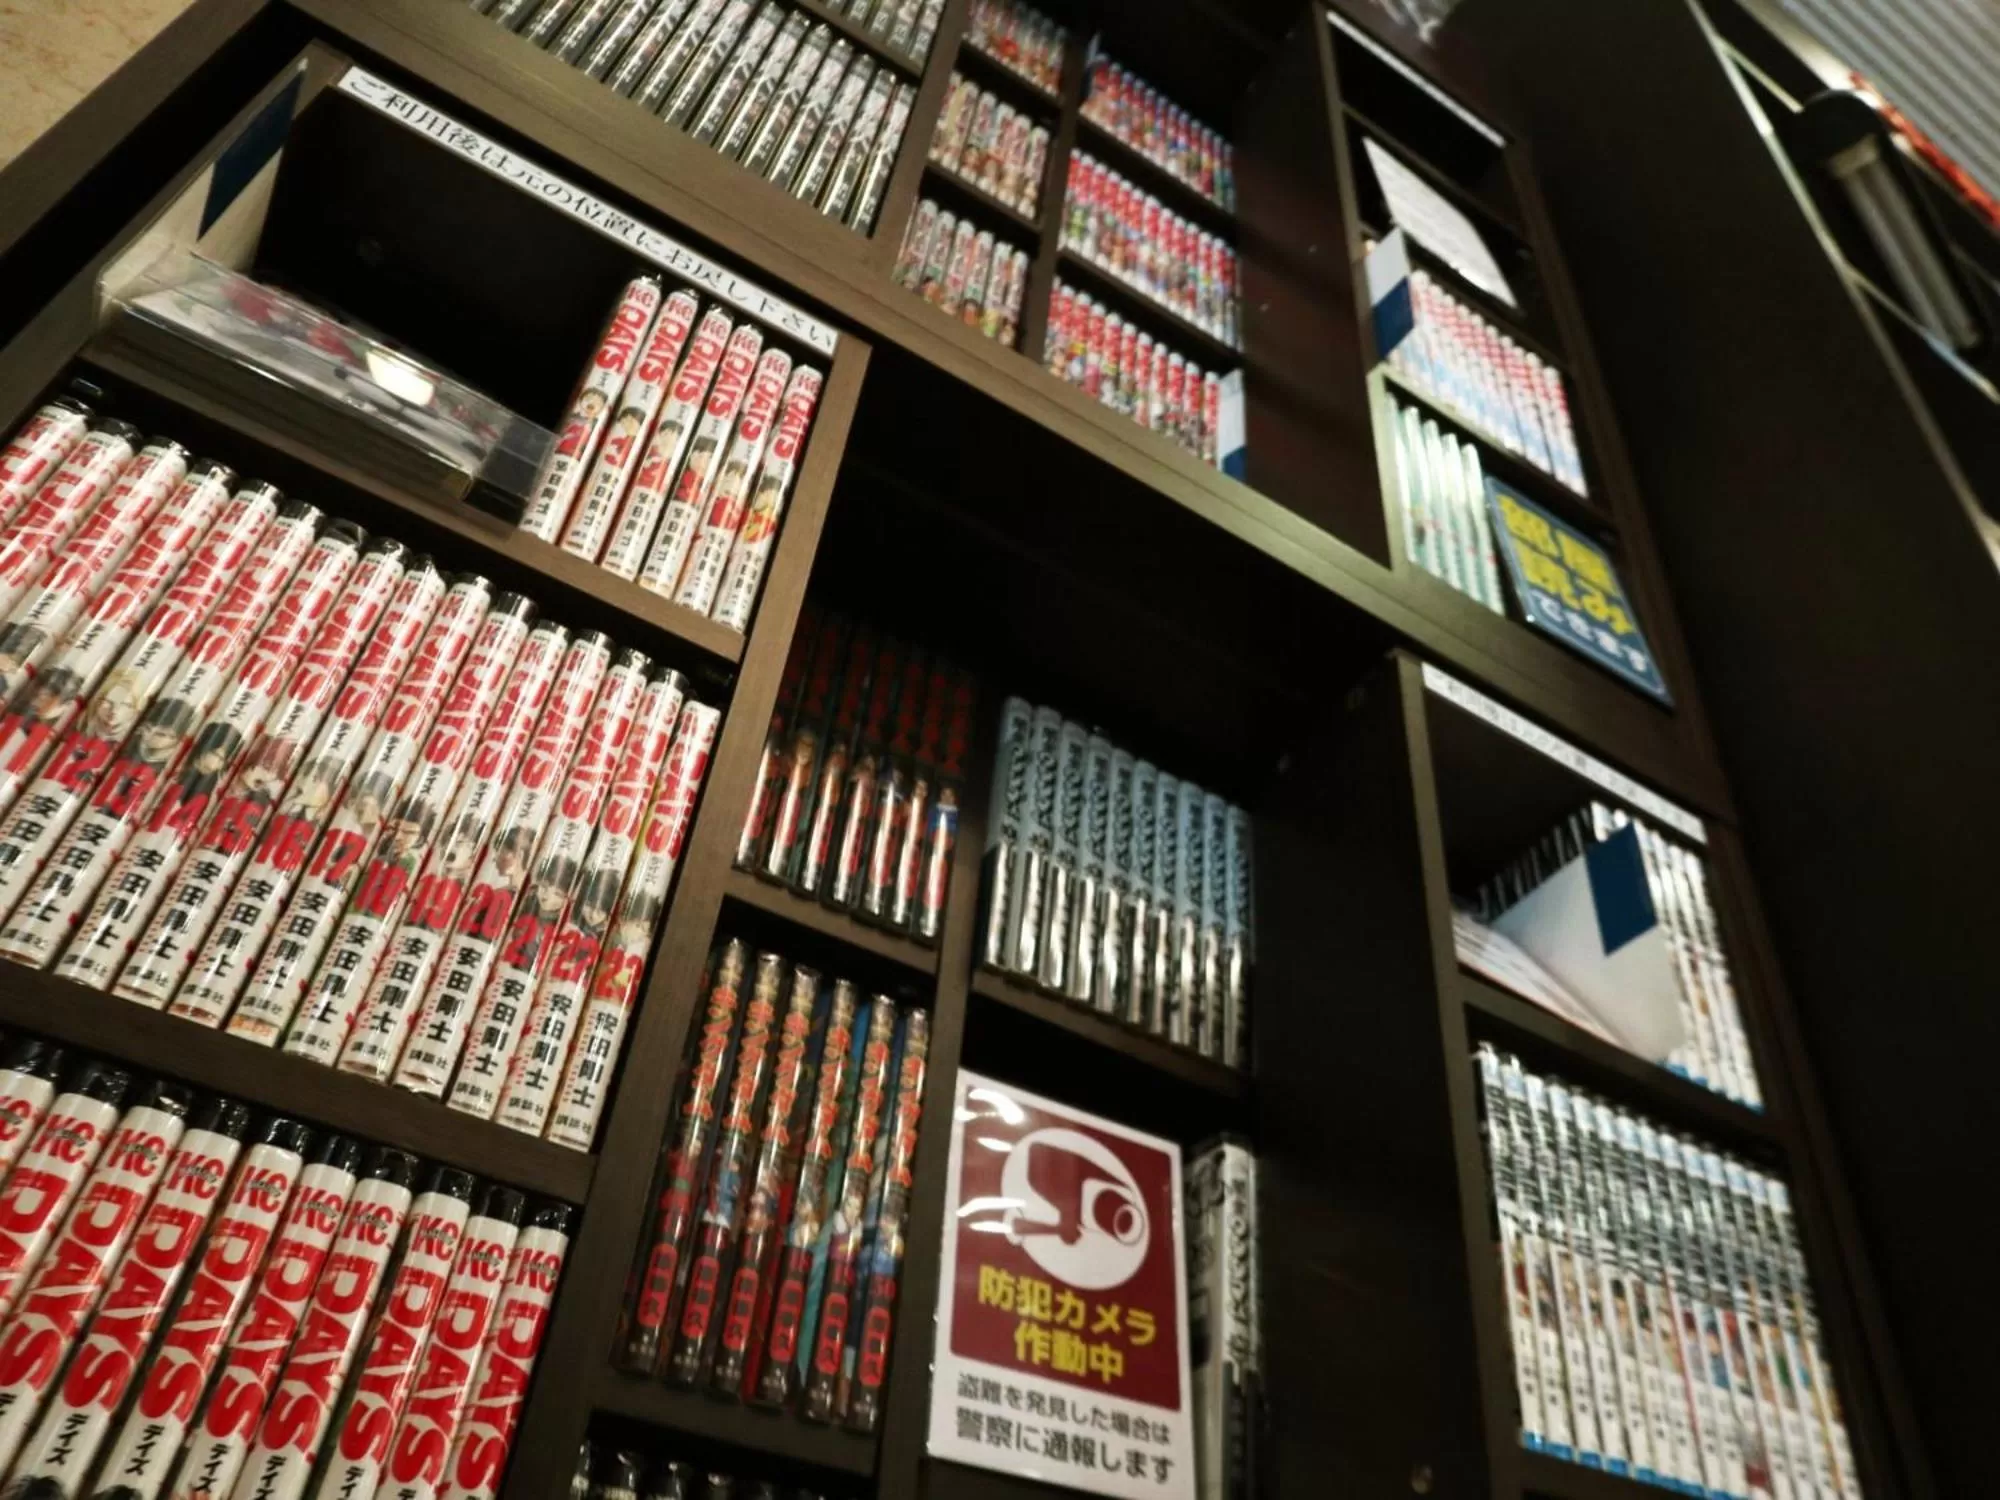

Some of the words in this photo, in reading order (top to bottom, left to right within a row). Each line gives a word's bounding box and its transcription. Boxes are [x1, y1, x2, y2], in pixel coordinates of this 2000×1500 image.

[350, 75, 834, 345] ご利用後は元の位置にお戻し下さい
[595, 305, 647, 372] DAYS
[637, 317, 688, 388] DAYS
[672, 337, 722, 404] DAYS
[707, 350, 754, 418] DAYS
[740, 375, 783, 442] DAYS
[773, 393, 816, 463] DAYS
[37, 485, 152, 593] DAYS
[90, 516, 200, 628] DAYS
[146, 531, 249, 645] DAYS
[189, 556, 287, 669] DAYS
[239, 580, 332, 697] DAYS
[290, 594, 377, 708] DAYS
[335, 611, 421, 724] DAYS
[384, 624, 466, 739] DAYS
[426, 654, 503, 770] DAYS
[39, 730, 114, 794] 12
[473, 670, 548, 788] DAYS
[521, 679, 591, 789] DAYS
[562, 708, 629, 824] DAYS
[89, 756, 160, 820] 13
[144, 782, 211, 844] 14
[604, 723, 665, 839] DAYS
[645, 743, 707, 859] DAYS
[200, 793, 268, 858] 15
[254, 811, 317, 875] 16
[307, 824, 368, 886] 17
[26, 822, 110, 924] 安田剛士
[88, 847, 166, 950] 安田剛士
[149, 860, 223, 960] 安田剛士
[352, 858, 410, 920] 18
[406, 870, 463, 934] 19
[459, 880, 515, 944] 20
[204, 878, 275, 978] 安田剛士
[261, 890, 328, 990] 安田剛士
[502, 912, 560, 978] 21
[548, 923, 602, 991] 22
[311, 924, 373, 1024] 安田剛士
[369, 936, 428, 1036] 安田剛士
[427, 946, 482, 1044] 安田剛士
[593, 945, 646, 1009] 23
[473, 978, 526, 1078] 安田剛士
[525, 992, 572, 1092] 安田剛士
[572, 1011, 618, 1110] 安田剛士
[29, 1112, 98, 1166] KC
[106, 1127, 170, 1180] KC
[166, 1150, 229, 1202] KC
[232, 1164, 294, 1216] KC
[290, 1185, 347, 1236] KC
[342, 1198, 398, 1248] KC
[410, 1213, 462, 1262] KC
[457, 1235, 507, 1284] KC
[514, 1246, 563, 1295] KC
[1, 1183, 141, 1388] DAYS
[65, 1205, 201, 1409] DAYS
[140, 1219, 268, 1421] DAYS
[979, 1264, 1157, 1345] 防犯カメラ
[206, 1238, 324, 1437] DAYS
[260, 1252, 376, 1451] DAYS
[340, 1268, 442, 1463] DAYS
[1014, 1322, 1124, 1384] 作動中
[389, 1290, 488, 1484] DAYS
[454, 1301, 546, 1490] DAYS
[957, 1373, 1172, 1446] 盗難を発見した場合は
[44, 1412, 89, 1467] デイズ
[124, 1424, 165, 1477] デイズ
[192, 1442, 231, 1496] デイズ
[956, 1407, 1175, 1484] 警察に通報します
[338, 1466, 364, 1500] デイ
